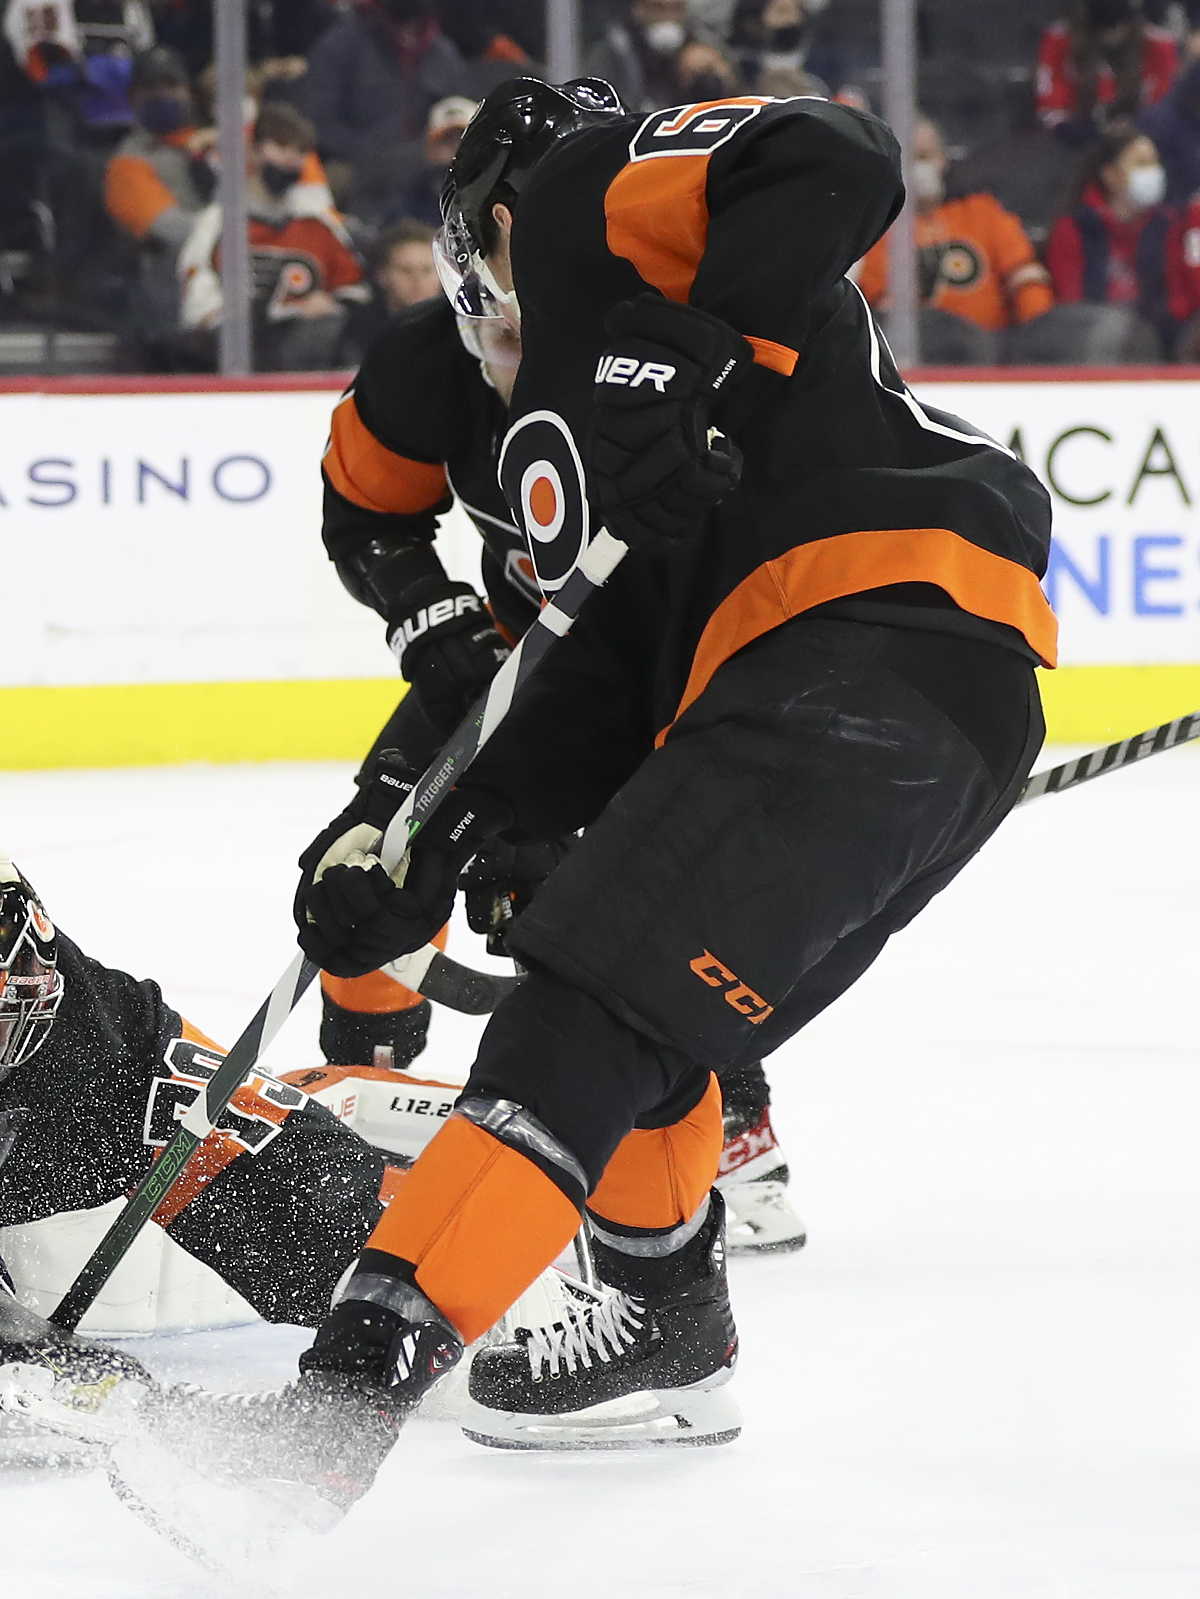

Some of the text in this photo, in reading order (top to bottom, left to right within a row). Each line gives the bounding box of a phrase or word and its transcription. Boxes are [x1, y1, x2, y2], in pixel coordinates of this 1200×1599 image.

[711, 358, 738, 390] BRAUN
[1047, 535, 1200, 616] NE
[379, 773, 414, 792] BAUE
[448, 810, 476, 842] BRAUN
[390, 1096, 453, 1119] L12.2
[144, 1129, 194, 1204] CCM
